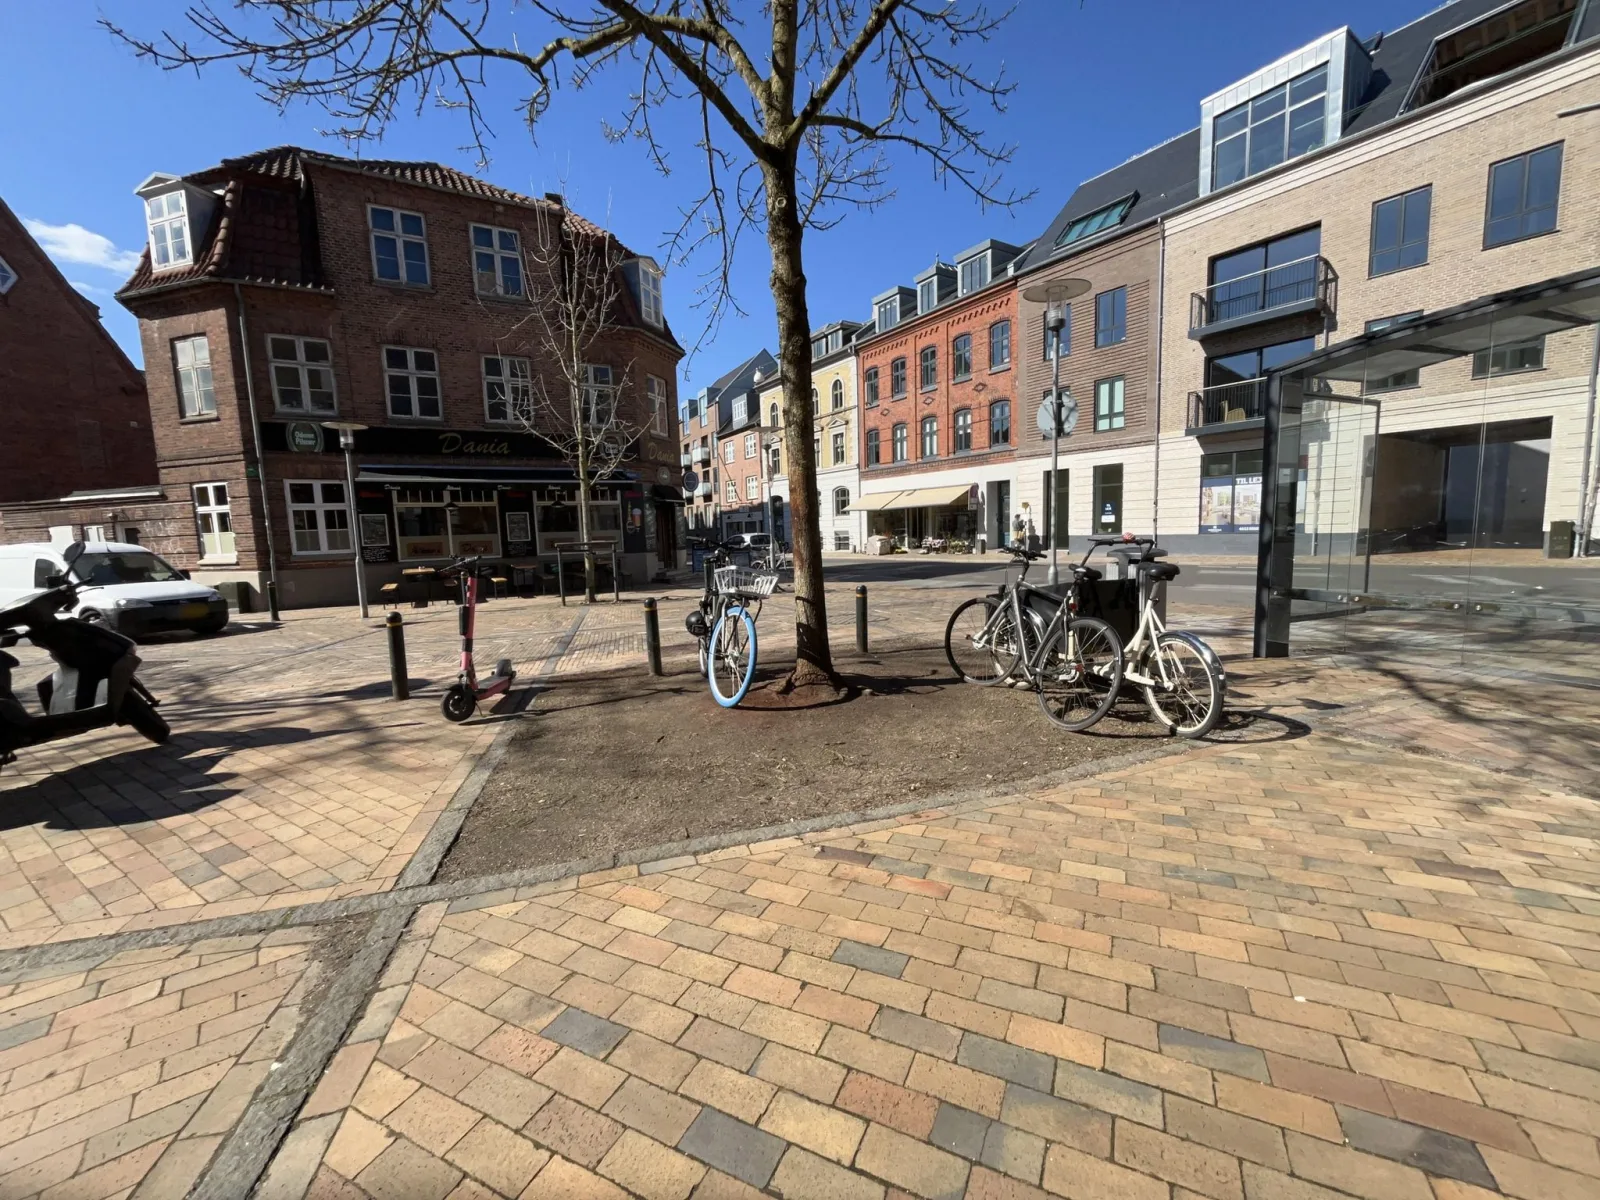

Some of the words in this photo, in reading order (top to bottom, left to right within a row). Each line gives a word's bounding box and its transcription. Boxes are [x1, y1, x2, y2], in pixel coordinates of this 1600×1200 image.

[437, 432, 512, 454] Dania
[647, 441, 675, 463] Dania
[1235, 477, 1248, 485] TIL
